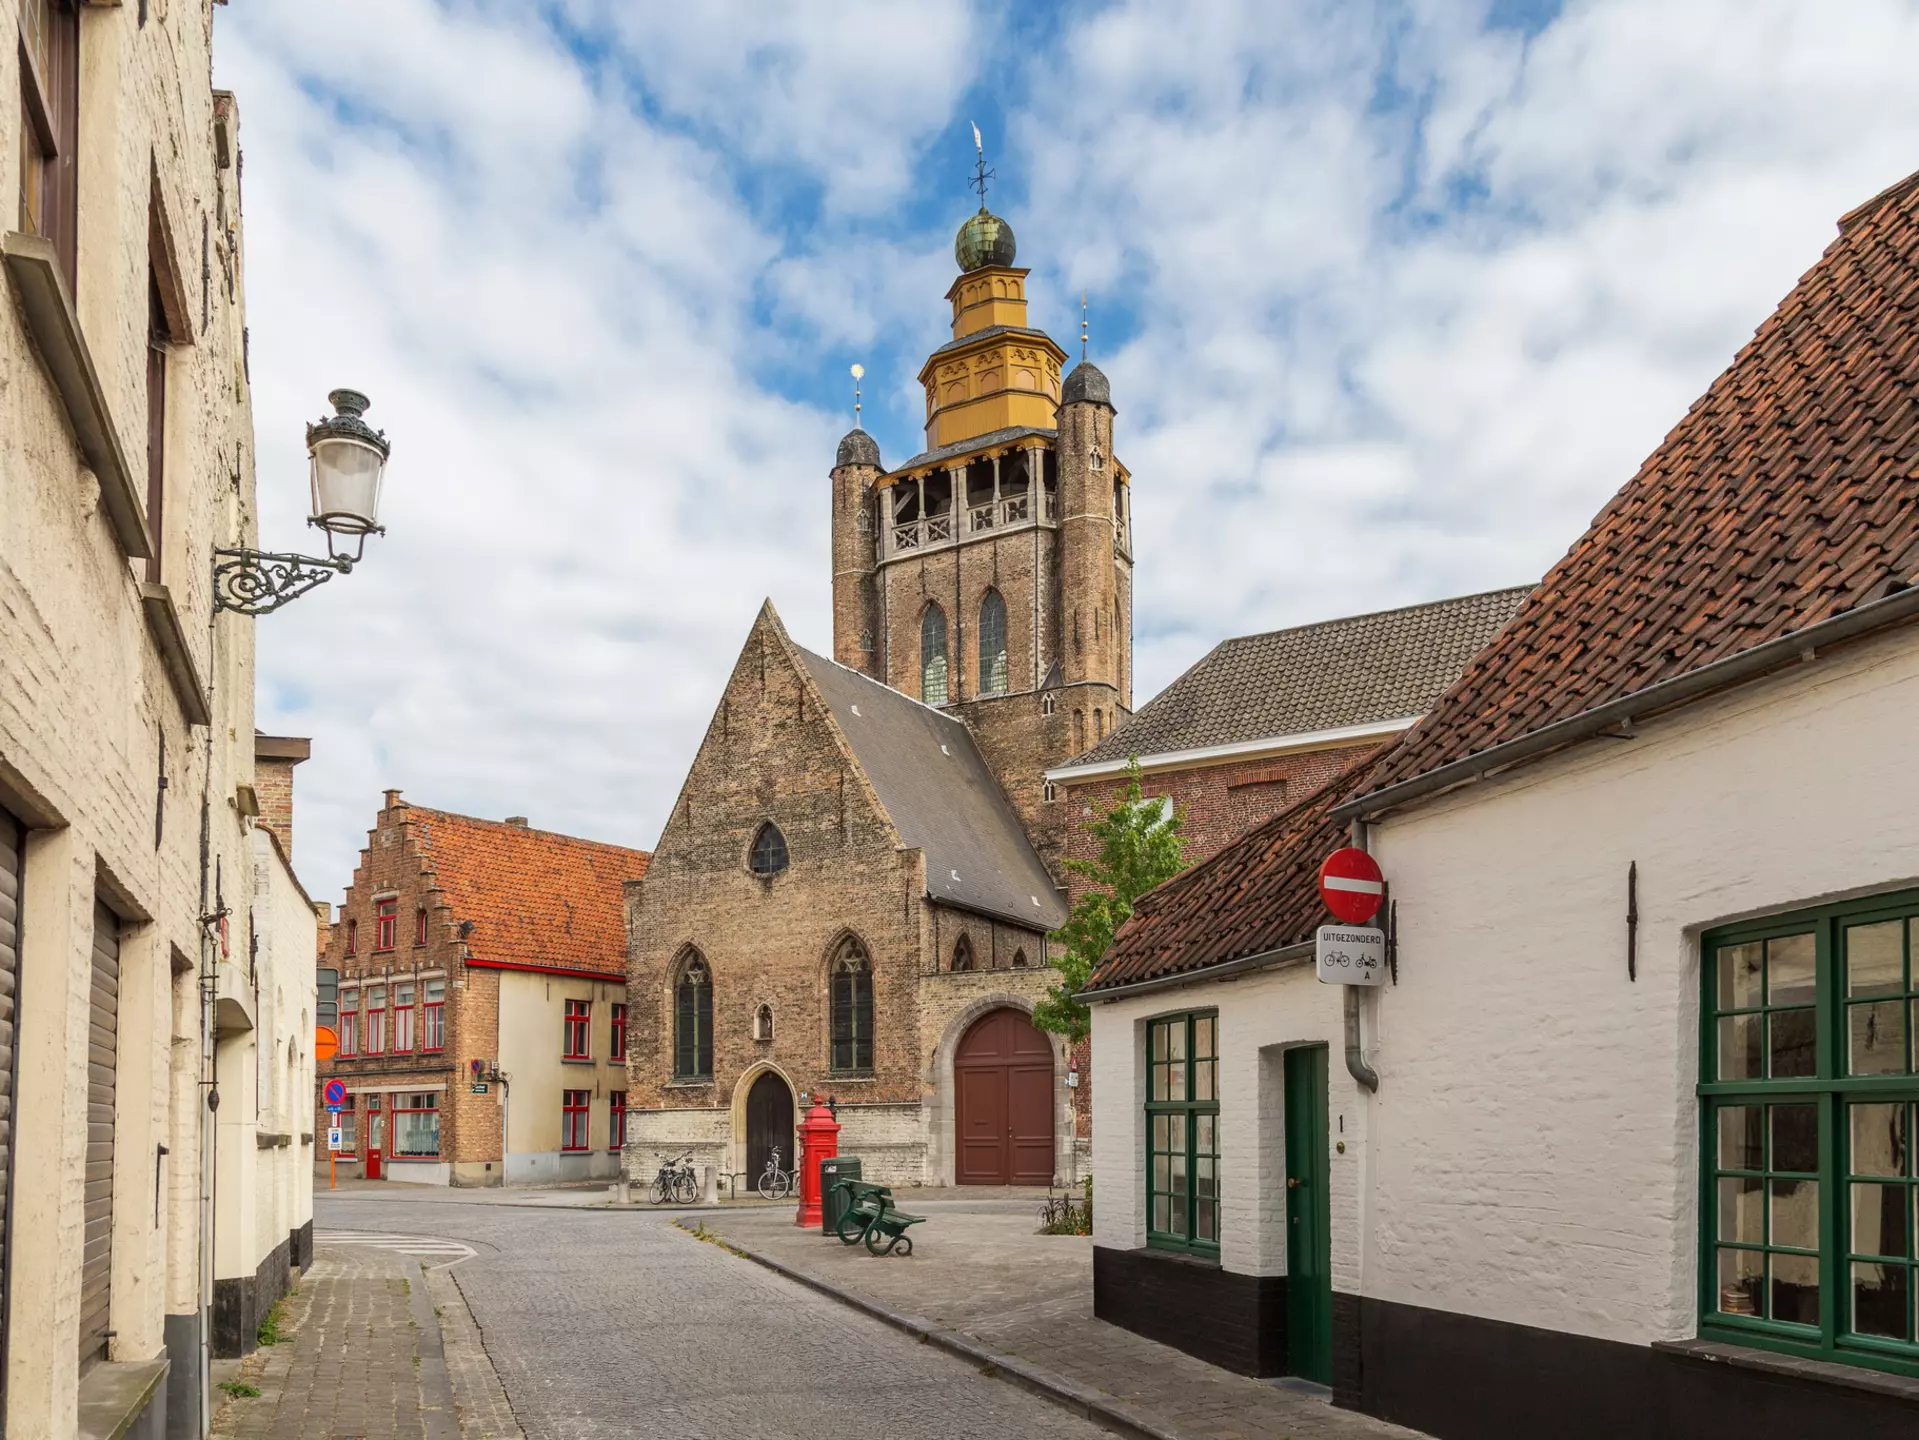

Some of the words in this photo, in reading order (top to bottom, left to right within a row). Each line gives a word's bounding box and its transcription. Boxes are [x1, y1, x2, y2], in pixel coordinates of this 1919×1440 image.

[1324, 932, 1380, 944] UITGEZONDERD
[1364, 971, 1370, 980] A
[1339, 1114, 1343, 1132] 1
